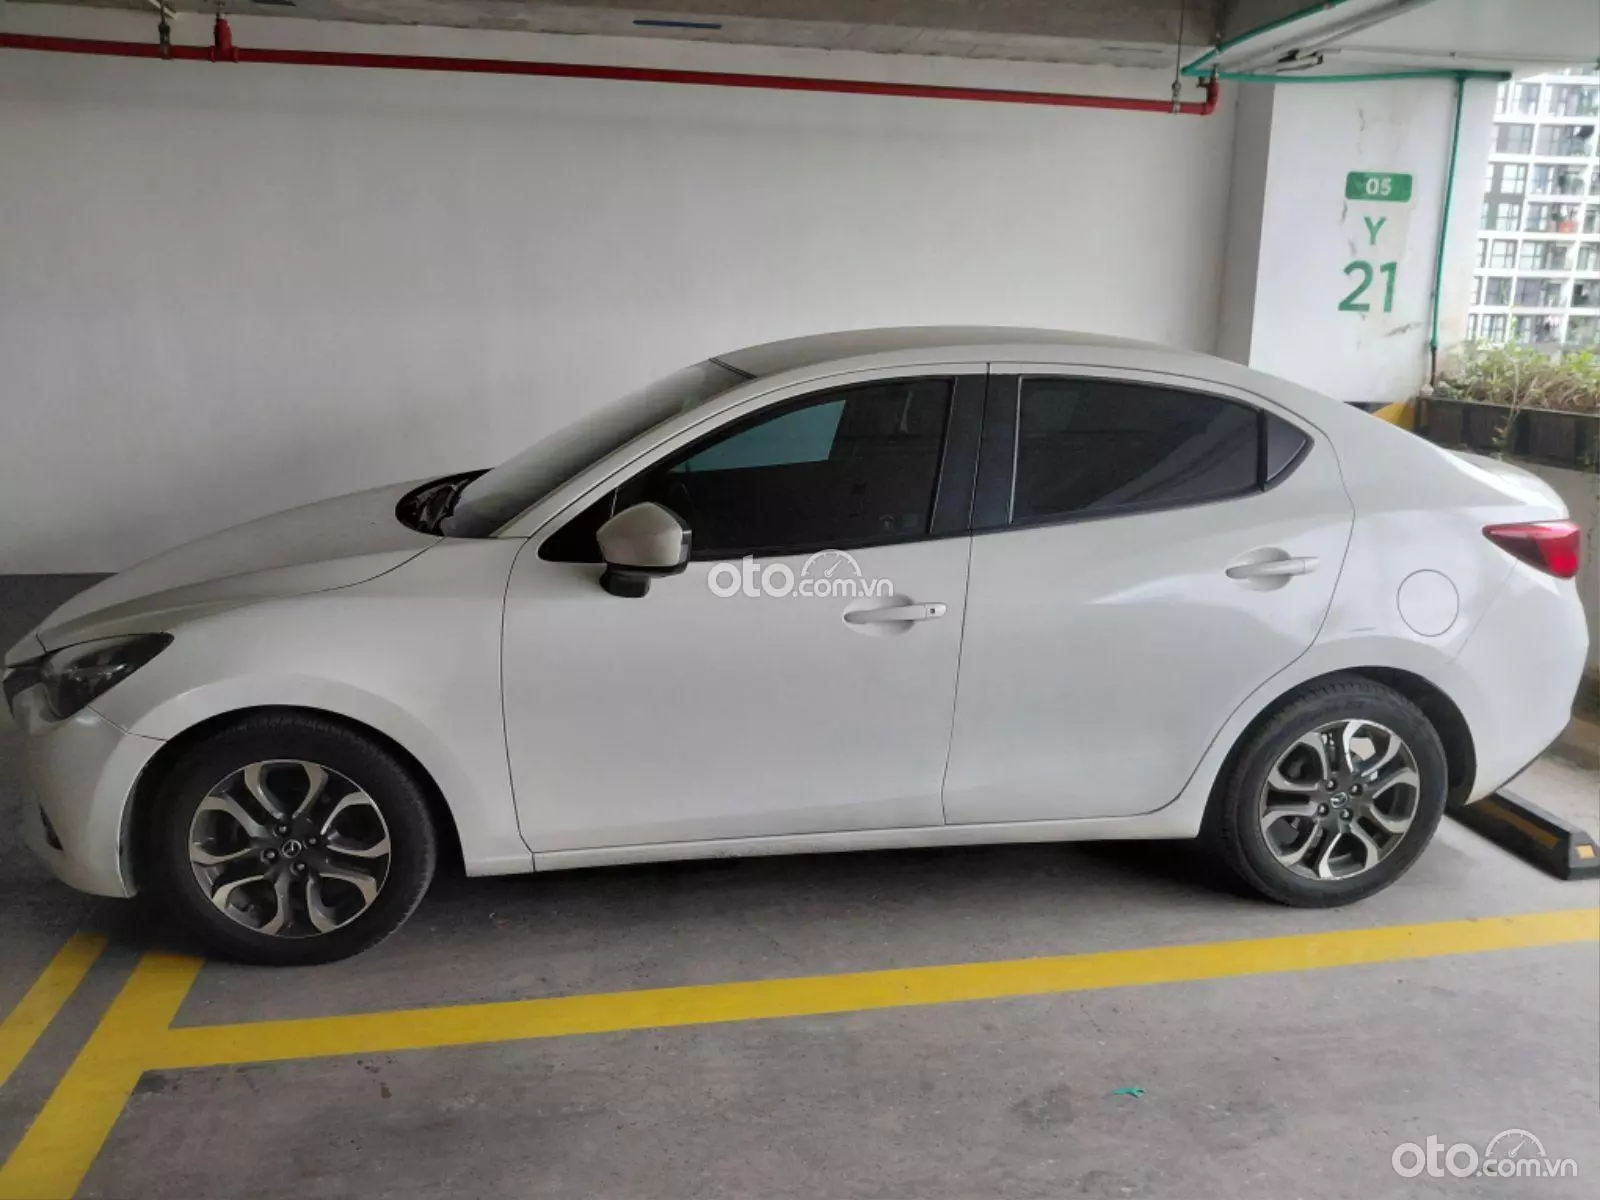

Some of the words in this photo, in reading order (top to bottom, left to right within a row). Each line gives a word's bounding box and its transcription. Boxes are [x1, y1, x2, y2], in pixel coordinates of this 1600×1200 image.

[1365, 178, 1391, 195] 05
[1364, 216, 1387, 245] Y
[1338, 260, 1397, 312] 21
